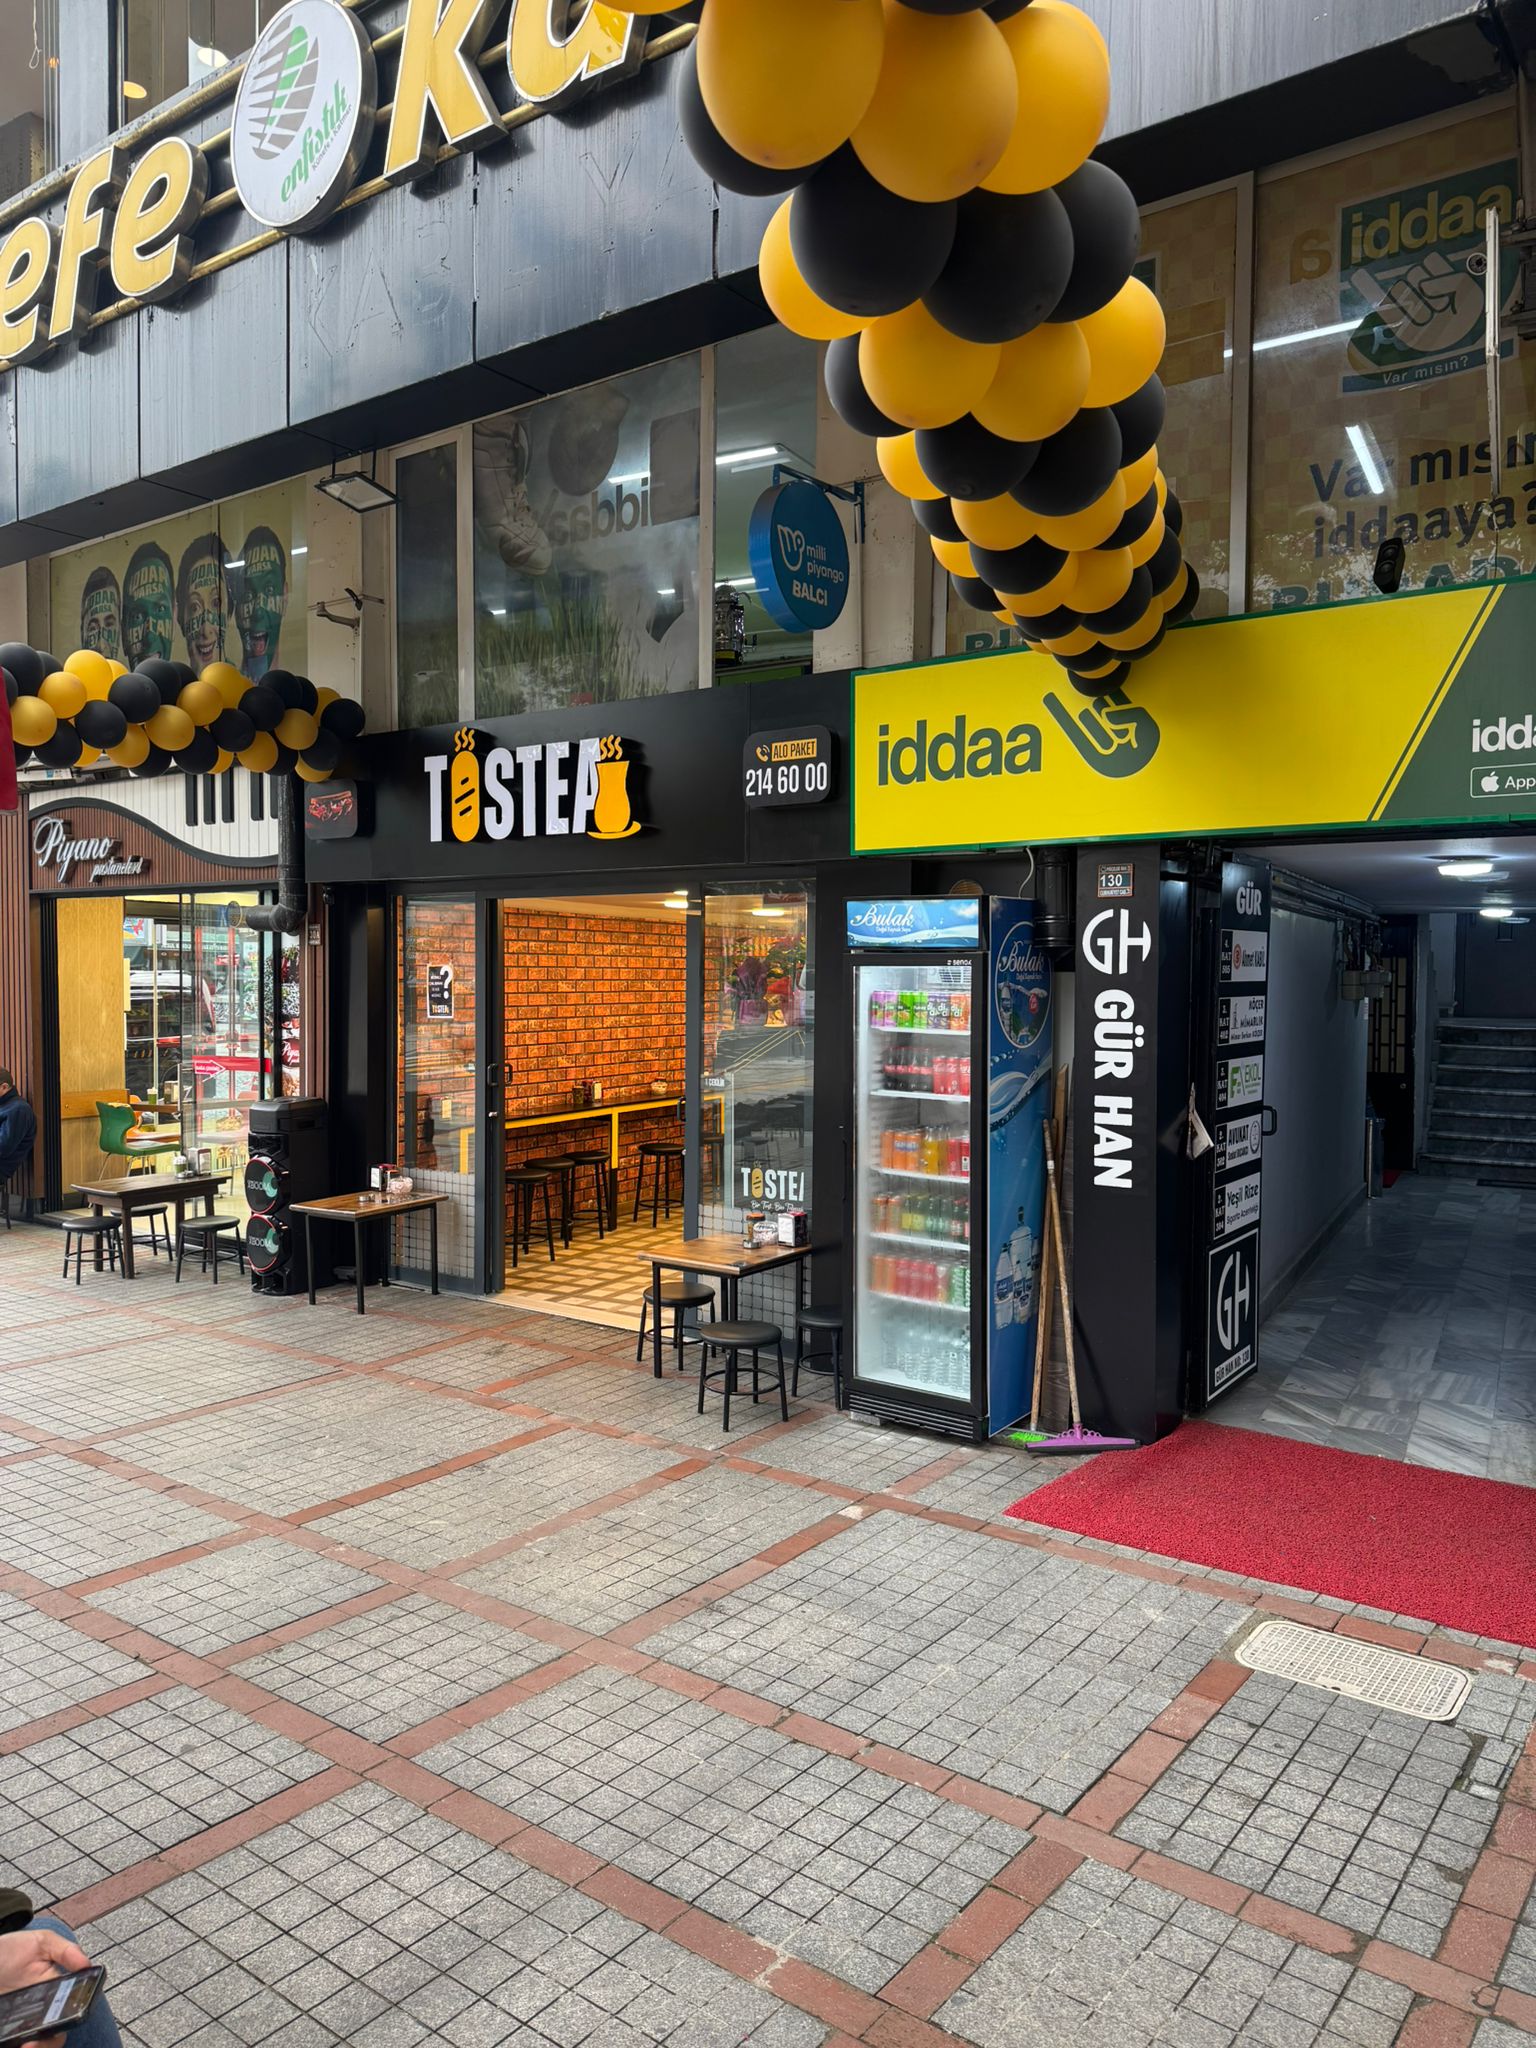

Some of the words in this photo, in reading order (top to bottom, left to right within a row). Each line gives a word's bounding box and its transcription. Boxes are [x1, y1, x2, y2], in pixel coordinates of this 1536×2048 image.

[1351, 185, 1512, 265] iddaa
[1383, 371, 1408, 385] Var
[806, 545, 826, 561] milli
[807, 560, 844, 584] piyango
[792, 579, 828, 606] BALCI
[1472, 714, 1536, 752] idd
[773, 744, 788, 759] ALO
[790, 741, 815, 757] PAKET
[878, 715, 1043, 787] iddaa
[745, 768, 773, 797] 214
[777, 765, 800, 794] 60
[805, 762, 828, 792] 00
[33, 816, 114, 882] Piyano
[1100, 874, 1122, 887] 130
[1236, 881, 1262, 916] GÜR
[850, 903, 915, 927] Bulak
[999, 941, 1044, 972] Bulak
[1093, 989, 1145, 1080] GÜR
[1093, 1094, 1133, 1188] HAN
[1228, 1124, 1249, 1147] AVUKAT
[1227, 1187, 1243, 1208] Yeşil
[1244, 1184, 1259, 1200] Rize
[1216, 1250, 1250, 1350] GH
[1216, 1366, 1225, 1383] GÜR
[1225, 1360, 1234, 1377] HAN
